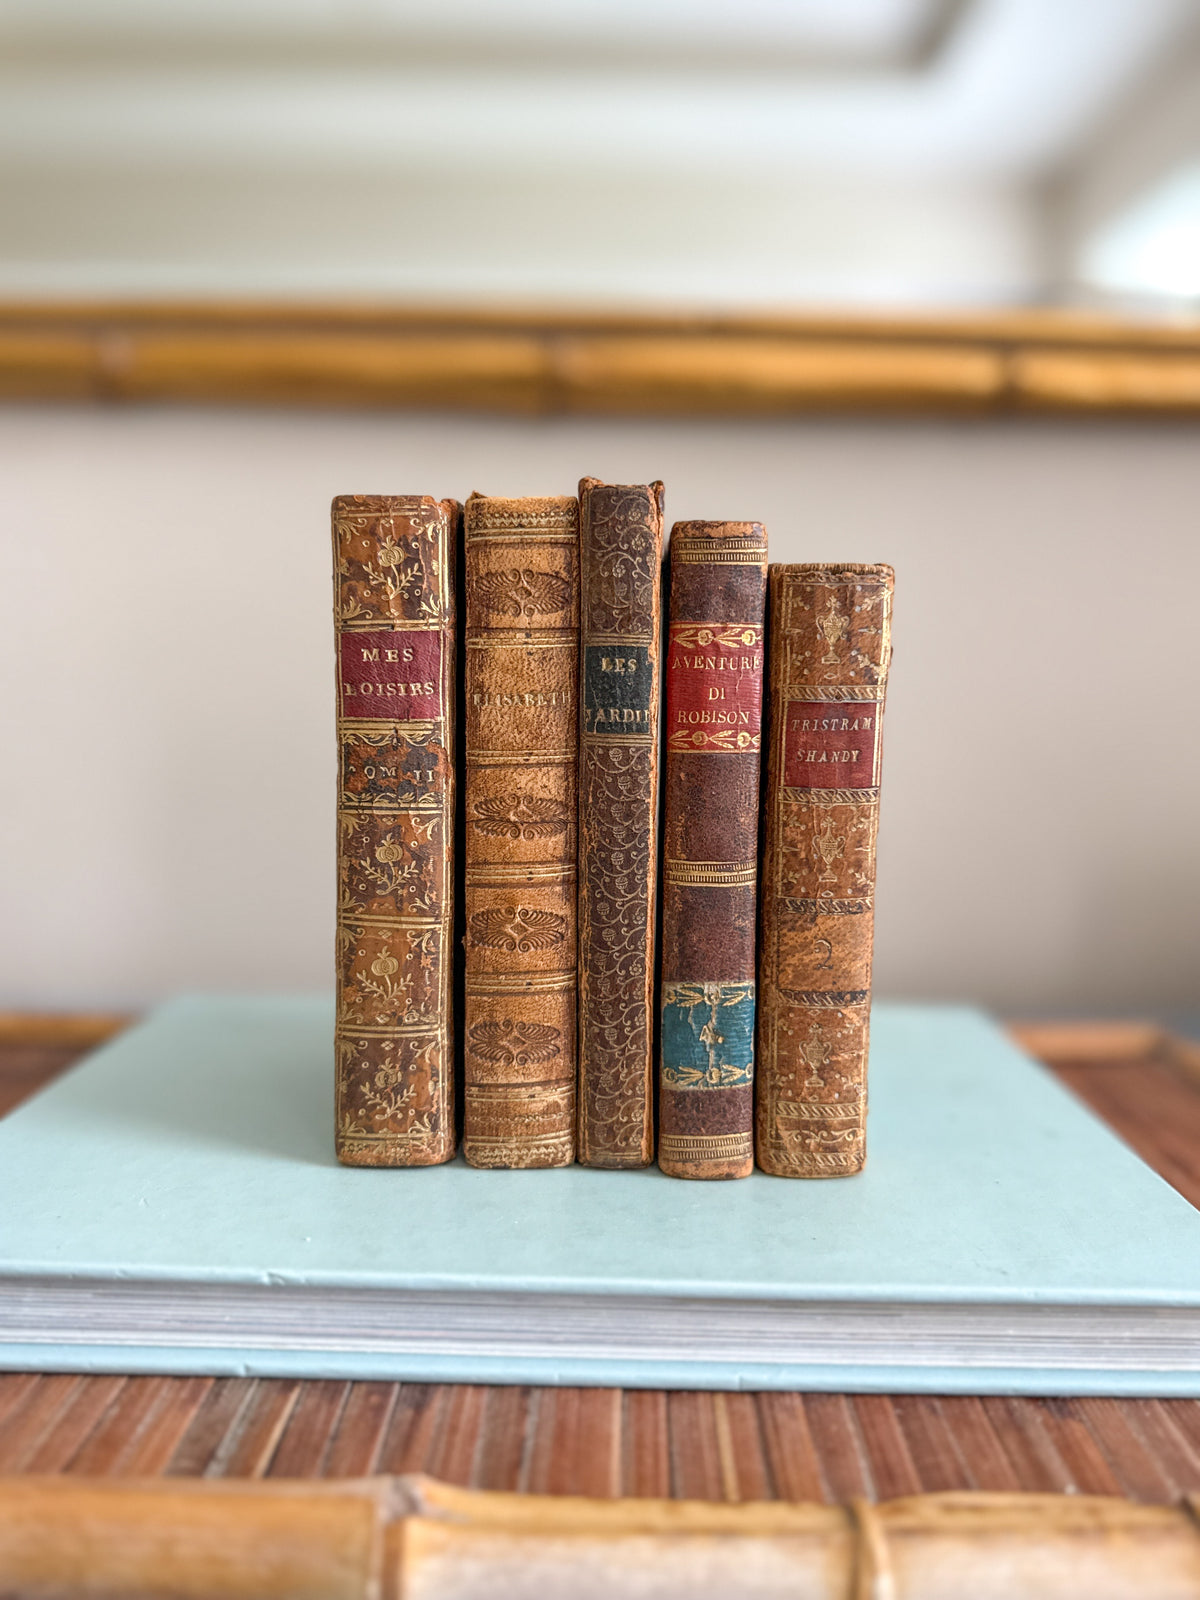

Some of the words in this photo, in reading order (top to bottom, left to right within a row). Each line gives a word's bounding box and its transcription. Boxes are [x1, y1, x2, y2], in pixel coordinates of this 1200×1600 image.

[361, 648, 414, 663] MES
[672, 655, 760, 670] AVENTURE
[601, 657, 637, 673] LES
[344, 682, 435, 697] LOISIRS
[708, 687, 726, 700] DI
[677, 710, 750, 725] ROBISON
[791, 717, 873, 732] TRISTRAM
[796, 748, 860, 763] SHANDY
